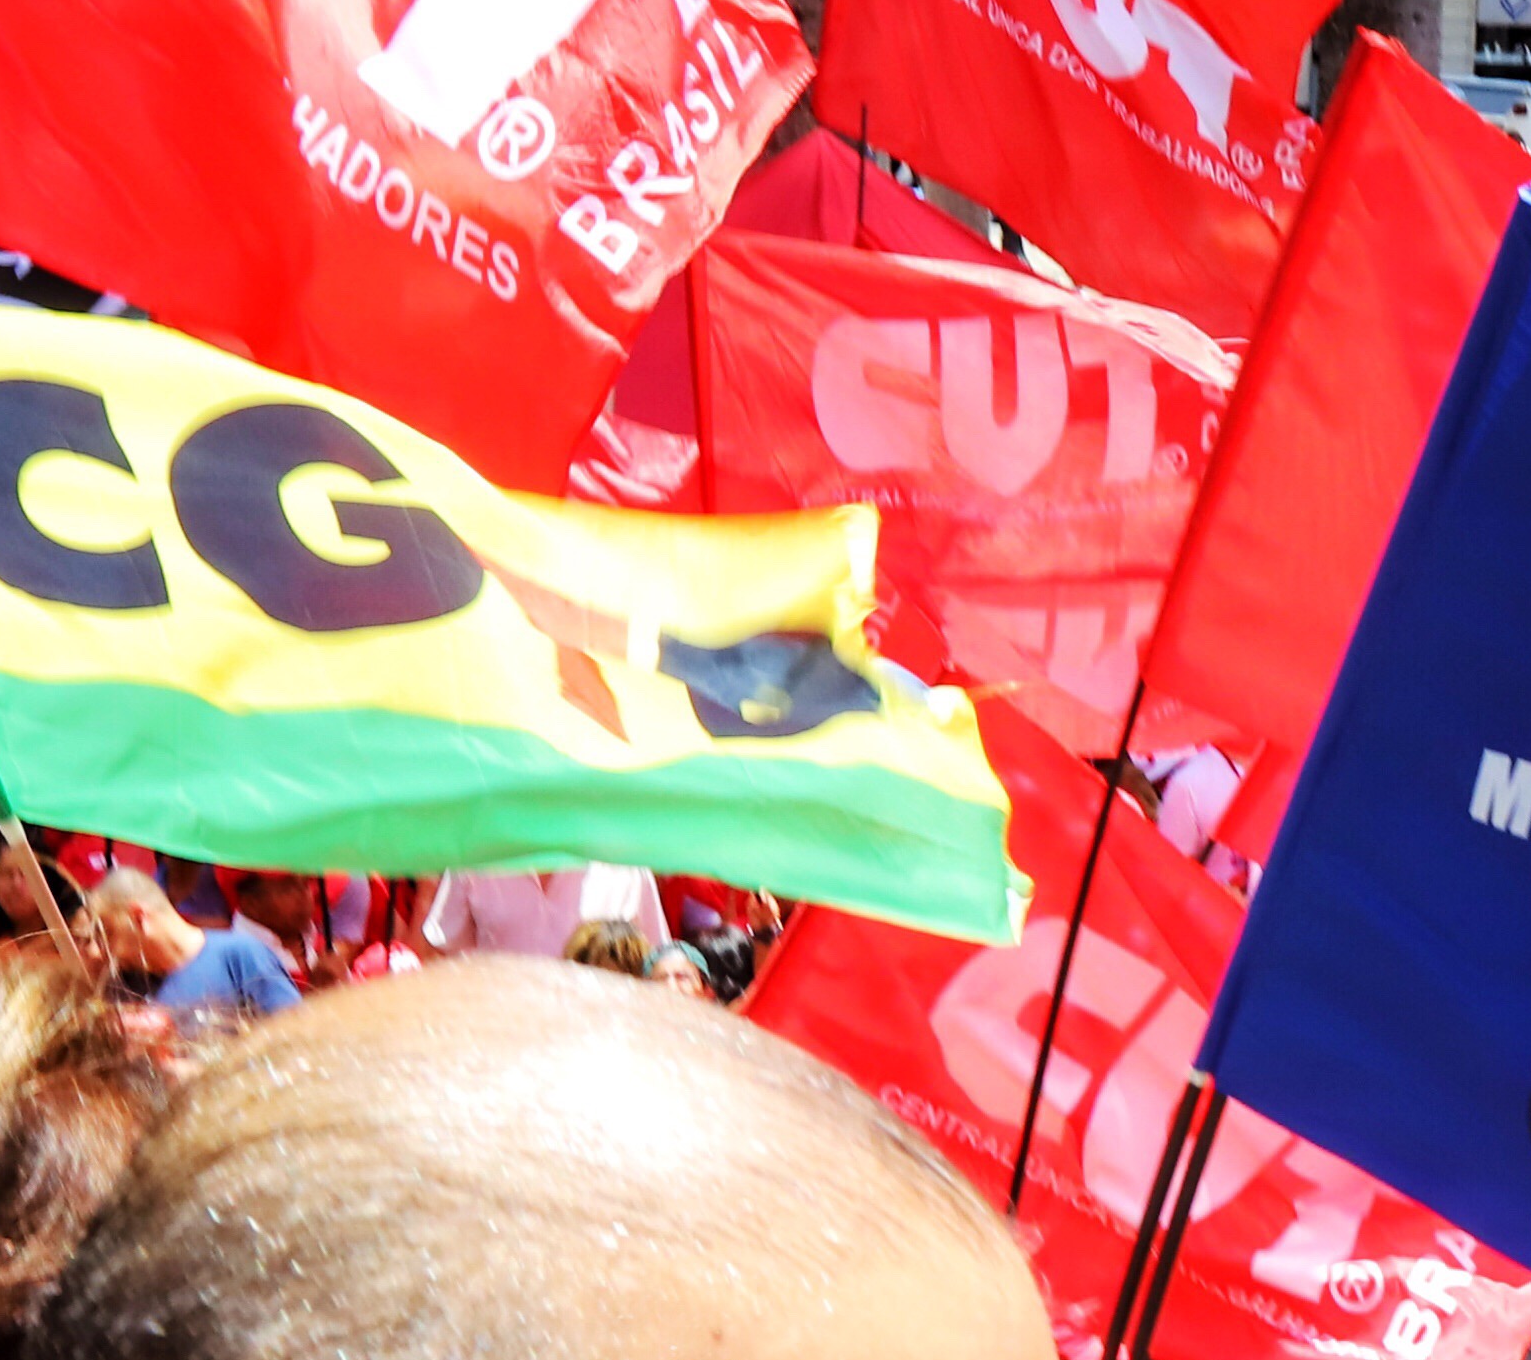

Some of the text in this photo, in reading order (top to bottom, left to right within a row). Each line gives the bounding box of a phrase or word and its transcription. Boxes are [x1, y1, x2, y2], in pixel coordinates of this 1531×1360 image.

[559, 11, 765, 275] BRASIL
[811, 314, 1158, 497] CUT
[879, 1083, 1014, 1165] CENTRAL
